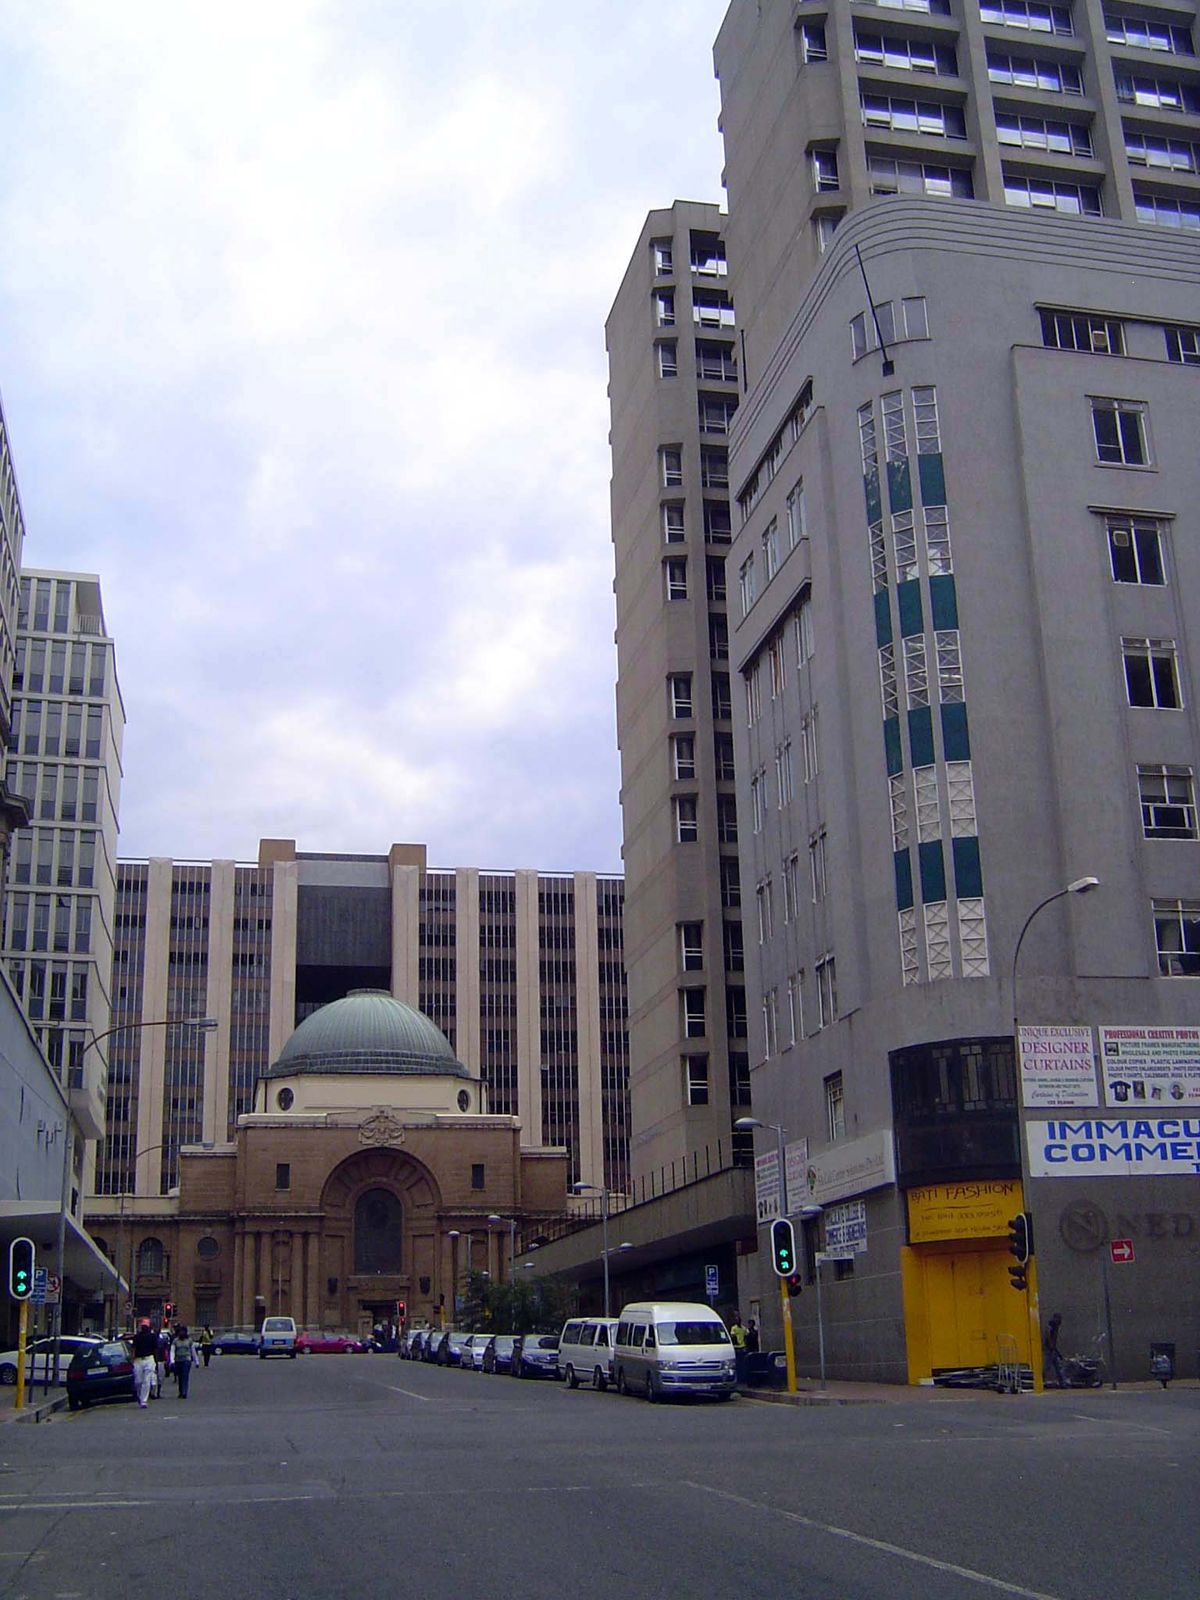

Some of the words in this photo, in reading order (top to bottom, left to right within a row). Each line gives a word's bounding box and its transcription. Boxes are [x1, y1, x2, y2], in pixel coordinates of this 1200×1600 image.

[1018, 1027, 1049, 1039] UNIQUE
[1050, 1027, 1090, 1037] EXCLUSIVE
[1104, 1030, 1146, 1039] PROFESSIONAL
[1147, 1030, 1175, 1039] CREATIVE
[1175, 1030, 1199, 1039] PHOTOS
[1021, 1041, 1091, 1054] DESIGNER
[1023, 1059, 1092, 1071] CURTAINS
[1047, 1120, 1200, 1140] IMMACU
[1044, 1142, 1200, 1162] COMME
[945, 1183, 1014, 1200] FASHION
[35, 1270, 43, 1279] P
[709, 1267, 715, 1276] P
